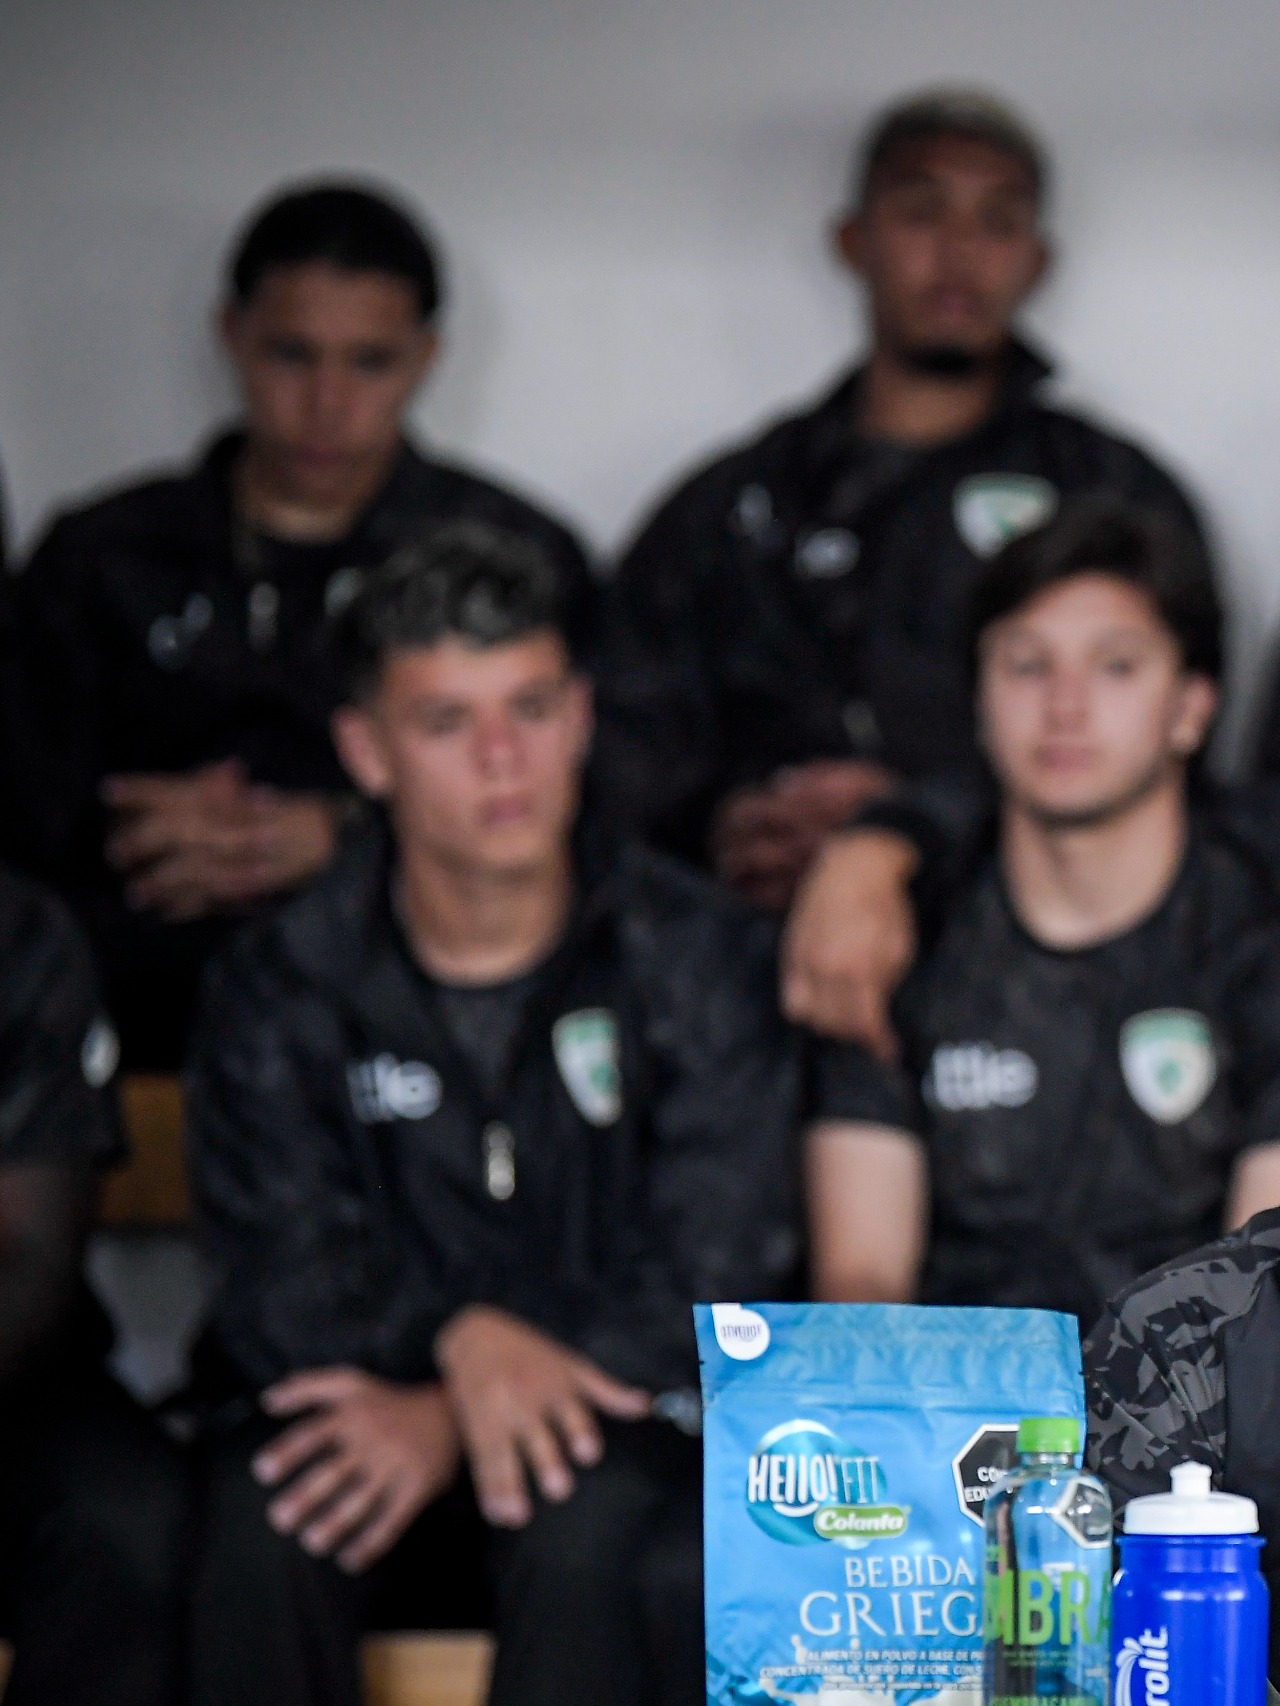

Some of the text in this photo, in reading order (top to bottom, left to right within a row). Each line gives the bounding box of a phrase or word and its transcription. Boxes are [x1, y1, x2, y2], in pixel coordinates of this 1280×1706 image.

[816, 1511, 905, 1532] Colanta
[844, 1554, 977, 1588] BEBIDA
[799, 1589, 983, 1637] GRIEG
